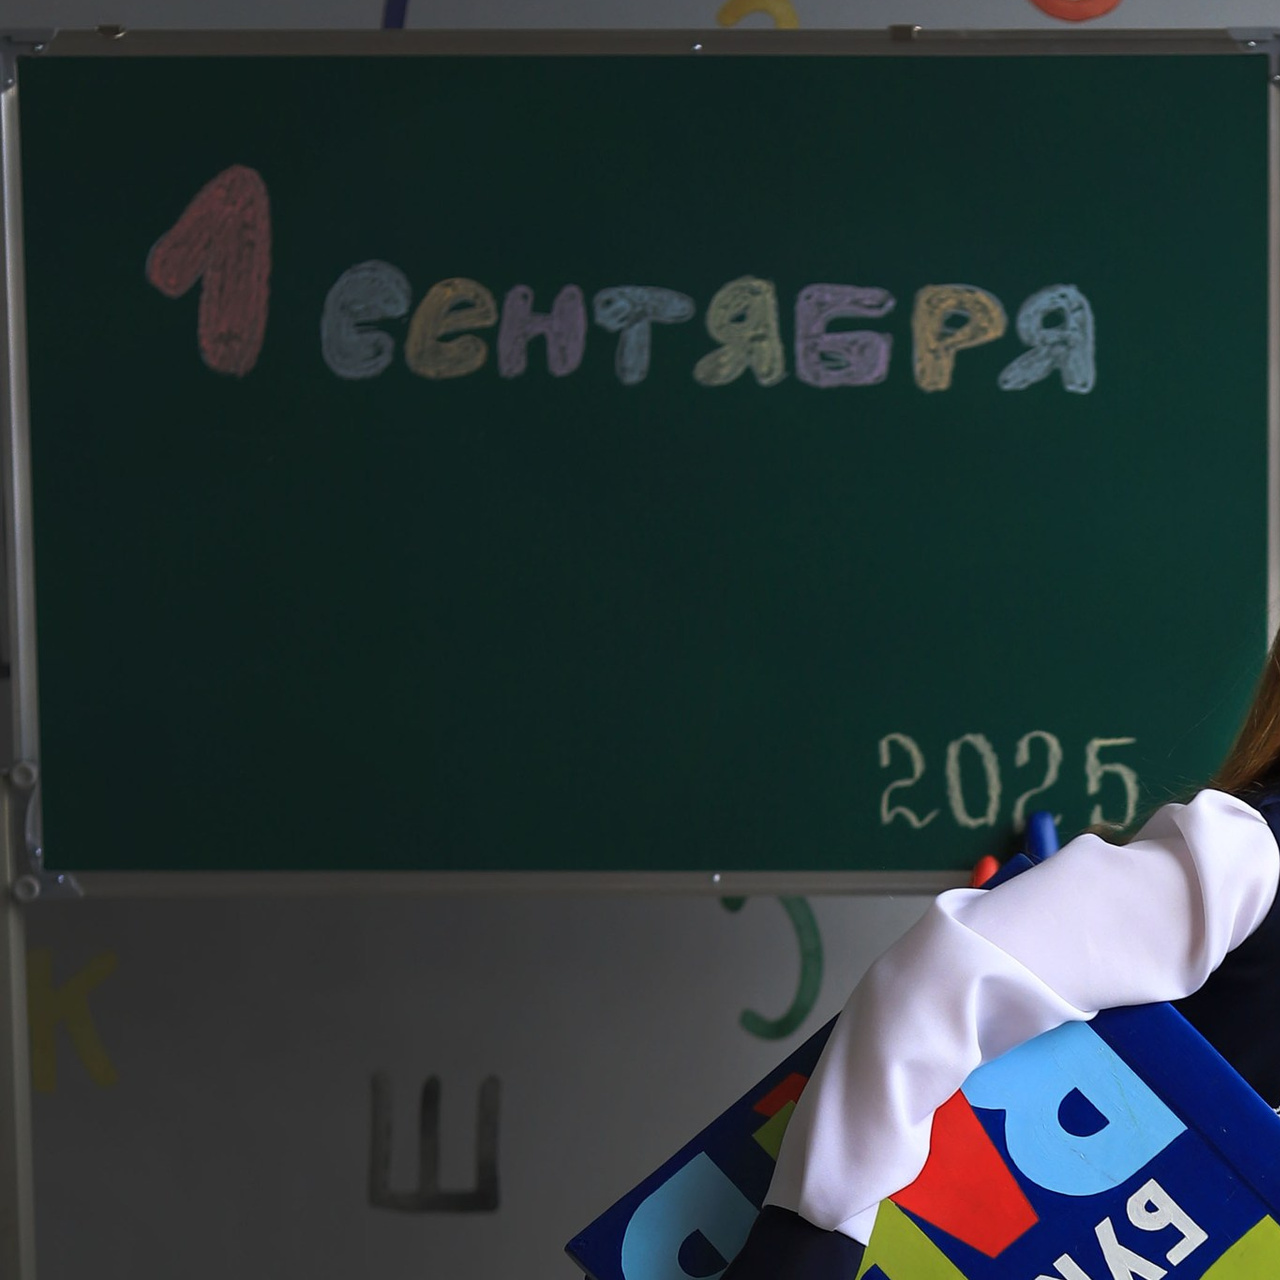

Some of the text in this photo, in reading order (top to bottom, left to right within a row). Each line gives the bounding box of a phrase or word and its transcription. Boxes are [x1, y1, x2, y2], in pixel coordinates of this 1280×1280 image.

[146, 163, 273, 377] 1
[878, 730, 1139, 835] 2025
[367, 1071, 501, 1213] Ш
